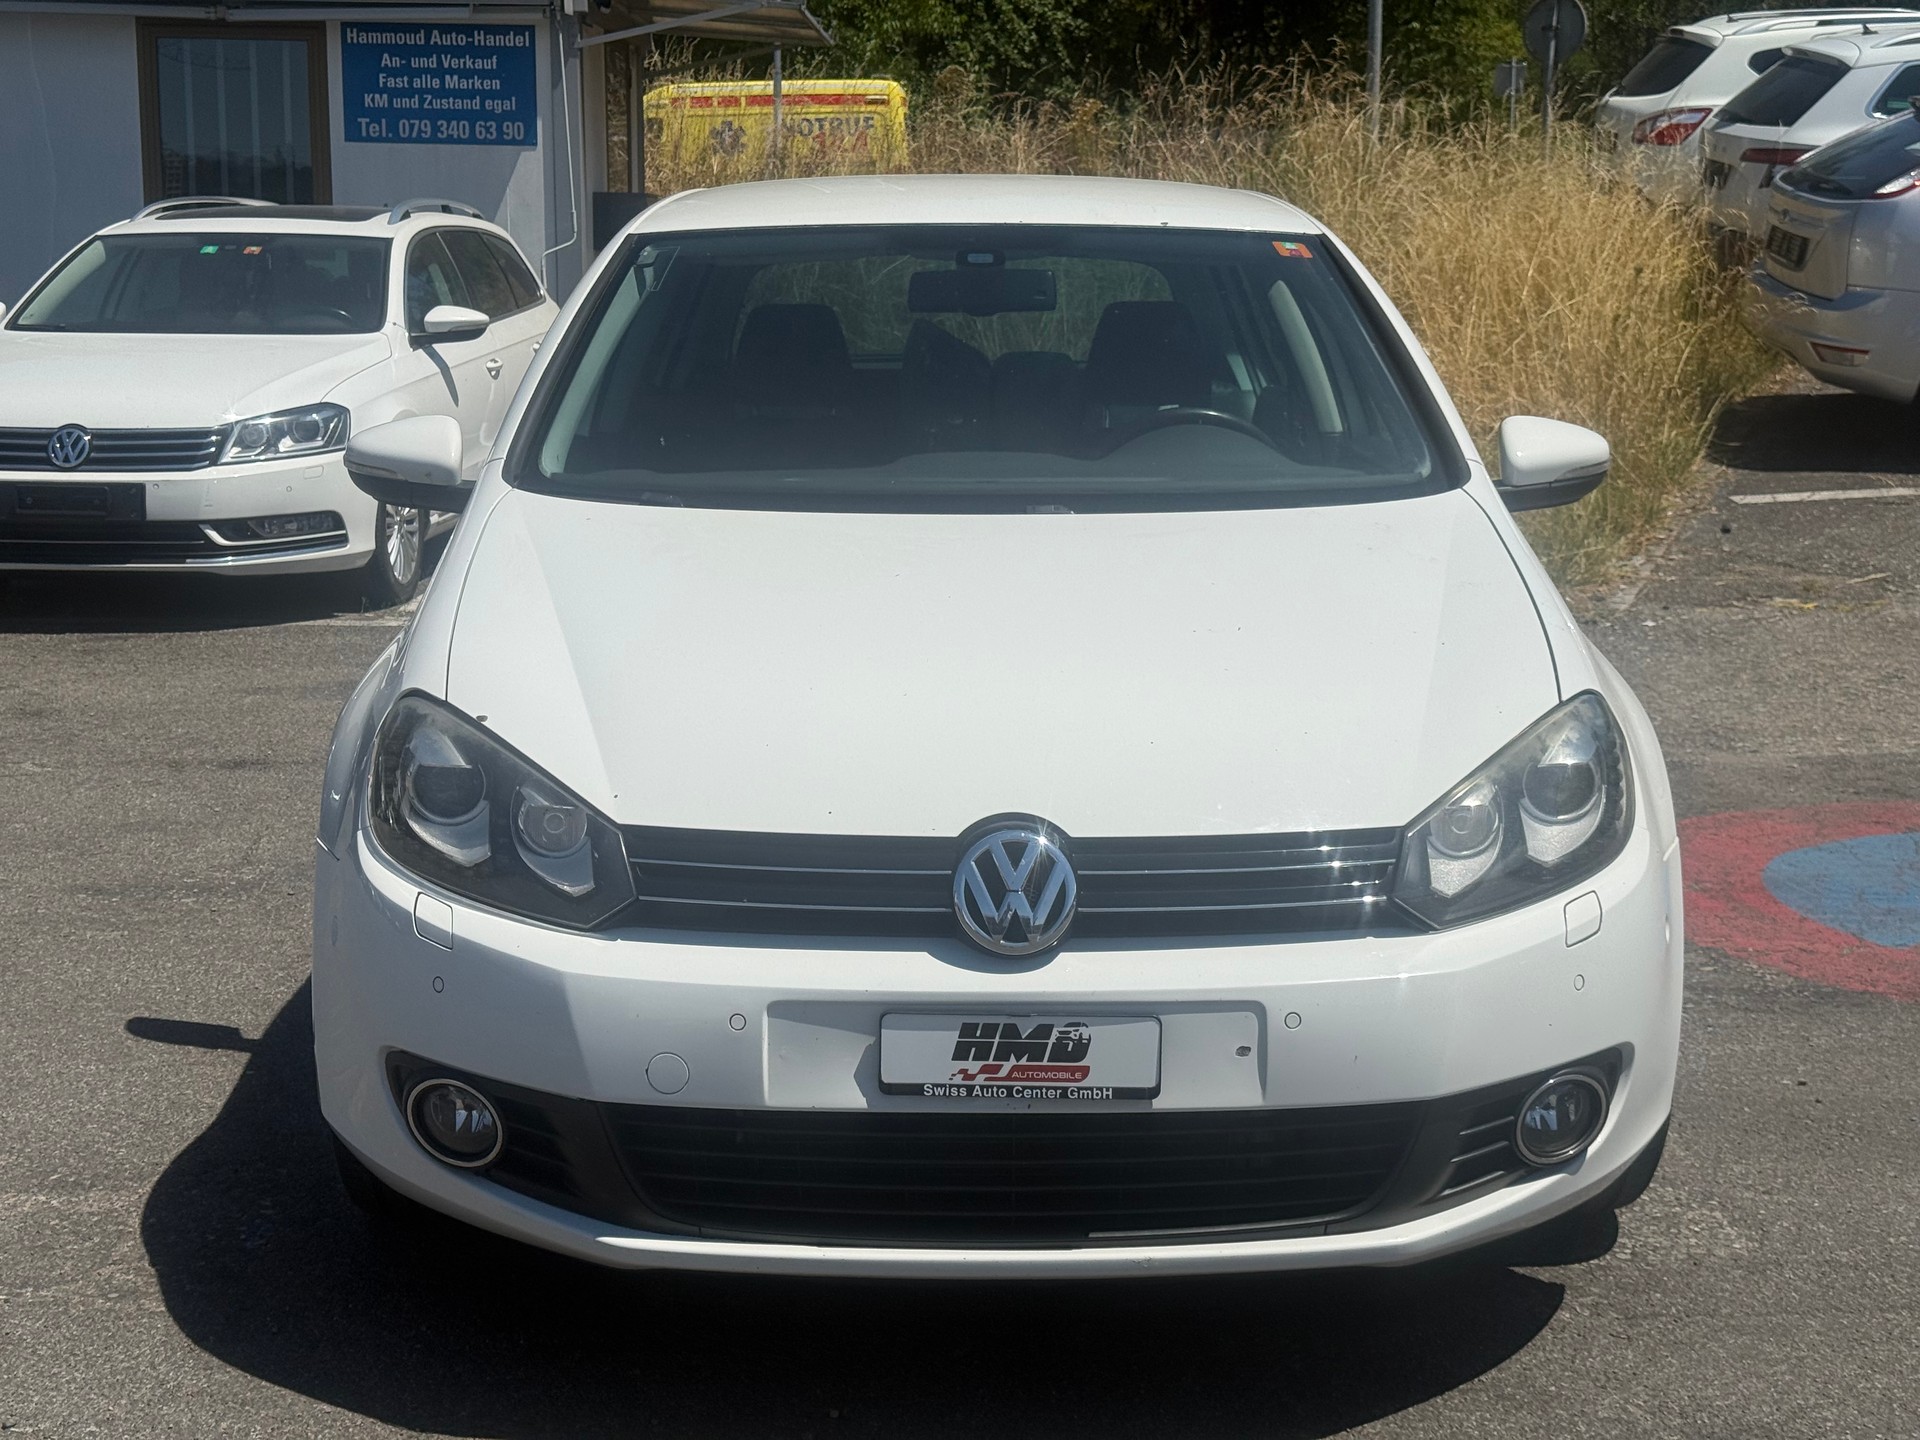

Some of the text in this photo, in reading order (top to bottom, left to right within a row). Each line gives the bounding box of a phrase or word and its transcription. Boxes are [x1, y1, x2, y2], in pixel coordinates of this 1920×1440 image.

[346, 28, 530, 47] Hammoud Auto-Handel
[381, 53, 498, 70] An- und Verkauf
[379, 73, 501, 90] Fast alle Marken
[364, 93, 516, 114] KM und Zustand egal
[357, 118, 525, 140] Tel. 079 340 63 90
[953, 830, 1076, 955] VW
[1011, 1070, 1083, 1080] AUTOMOBILE
[923, 1083, 1113, 1100] Swiss Auto Center GmbH
